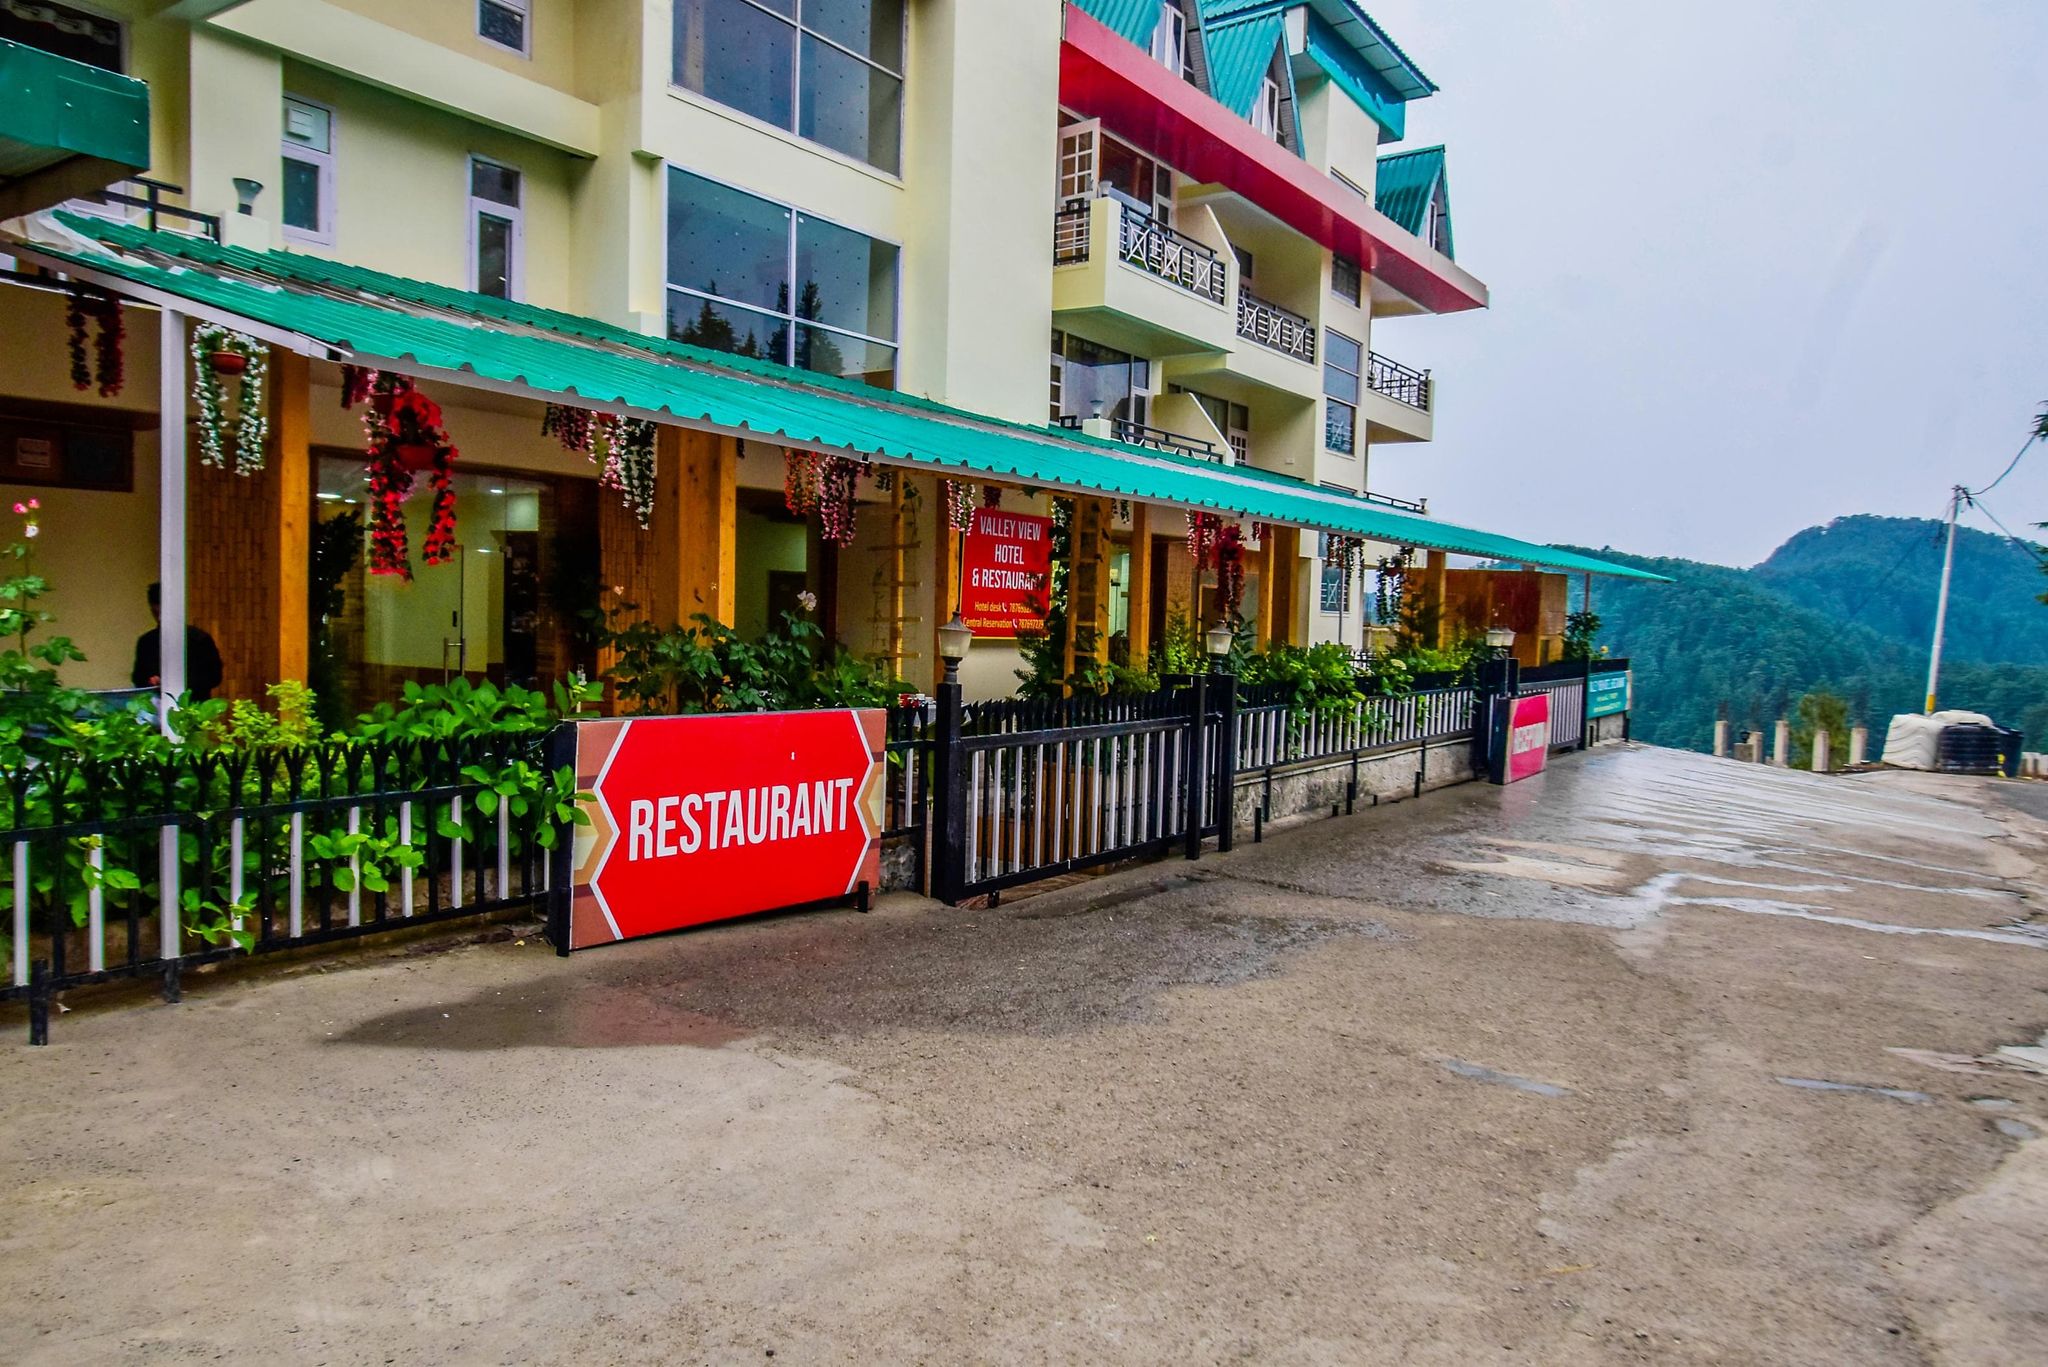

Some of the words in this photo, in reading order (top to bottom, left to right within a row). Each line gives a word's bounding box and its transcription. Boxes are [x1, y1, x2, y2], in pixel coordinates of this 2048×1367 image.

[980, 516, 1016, 538] VALLEY
[1018, 521, 1041, 541] VIEW
[994, 544, 1025, 565] HOTEL
[971, 568, 979, 587] &
[974, 601, 989, 612] Hotel
[989, 602, 1002, 612] desk
[962, 617, 983, 628] Central
[983, 618, 1013, 629] Reservation
[628, 777, 854, 862] RESTAURANT
